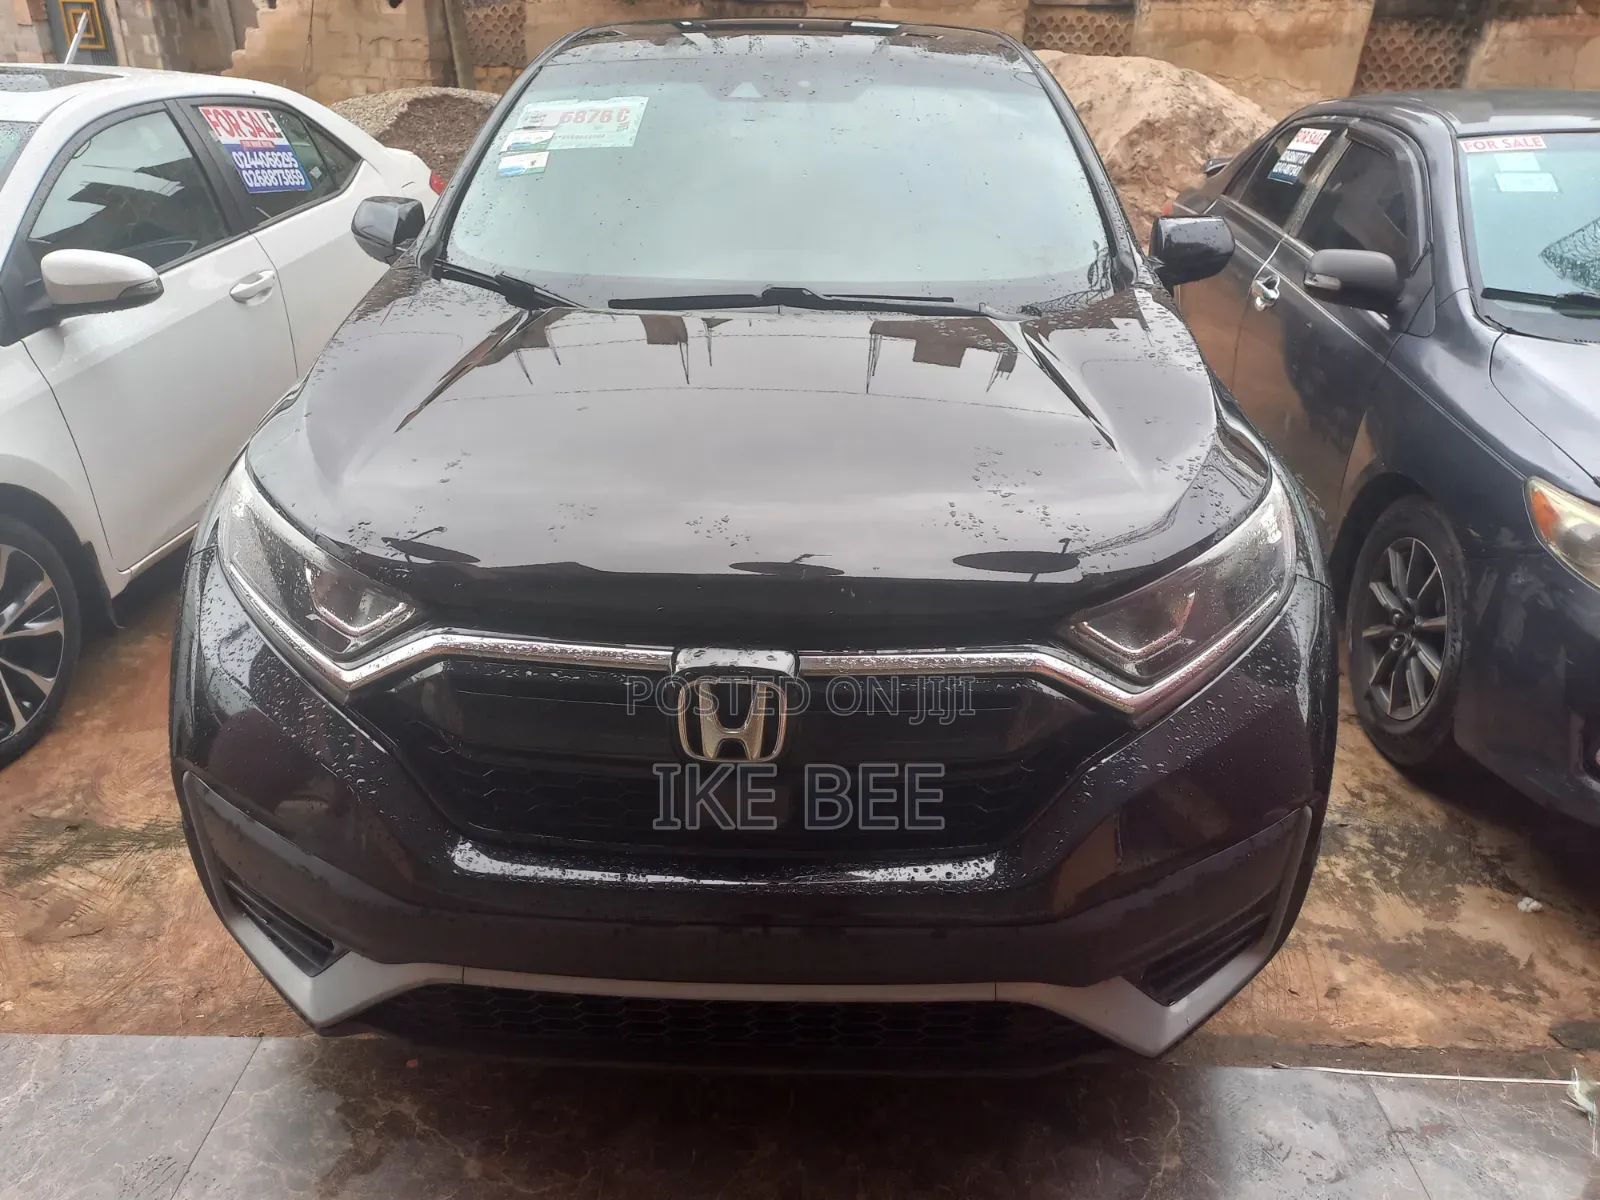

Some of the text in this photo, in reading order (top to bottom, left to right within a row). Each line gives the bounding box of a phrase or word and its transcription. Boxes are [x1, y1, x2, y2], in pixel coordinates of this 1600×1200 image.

[201, 108, 284, 139] FOR SALE
[1463, 136, 1543, 151] FOR SALE
[231, 151, 299, 169] 0244068295
[241, 169, 306, 188] 0268873859
